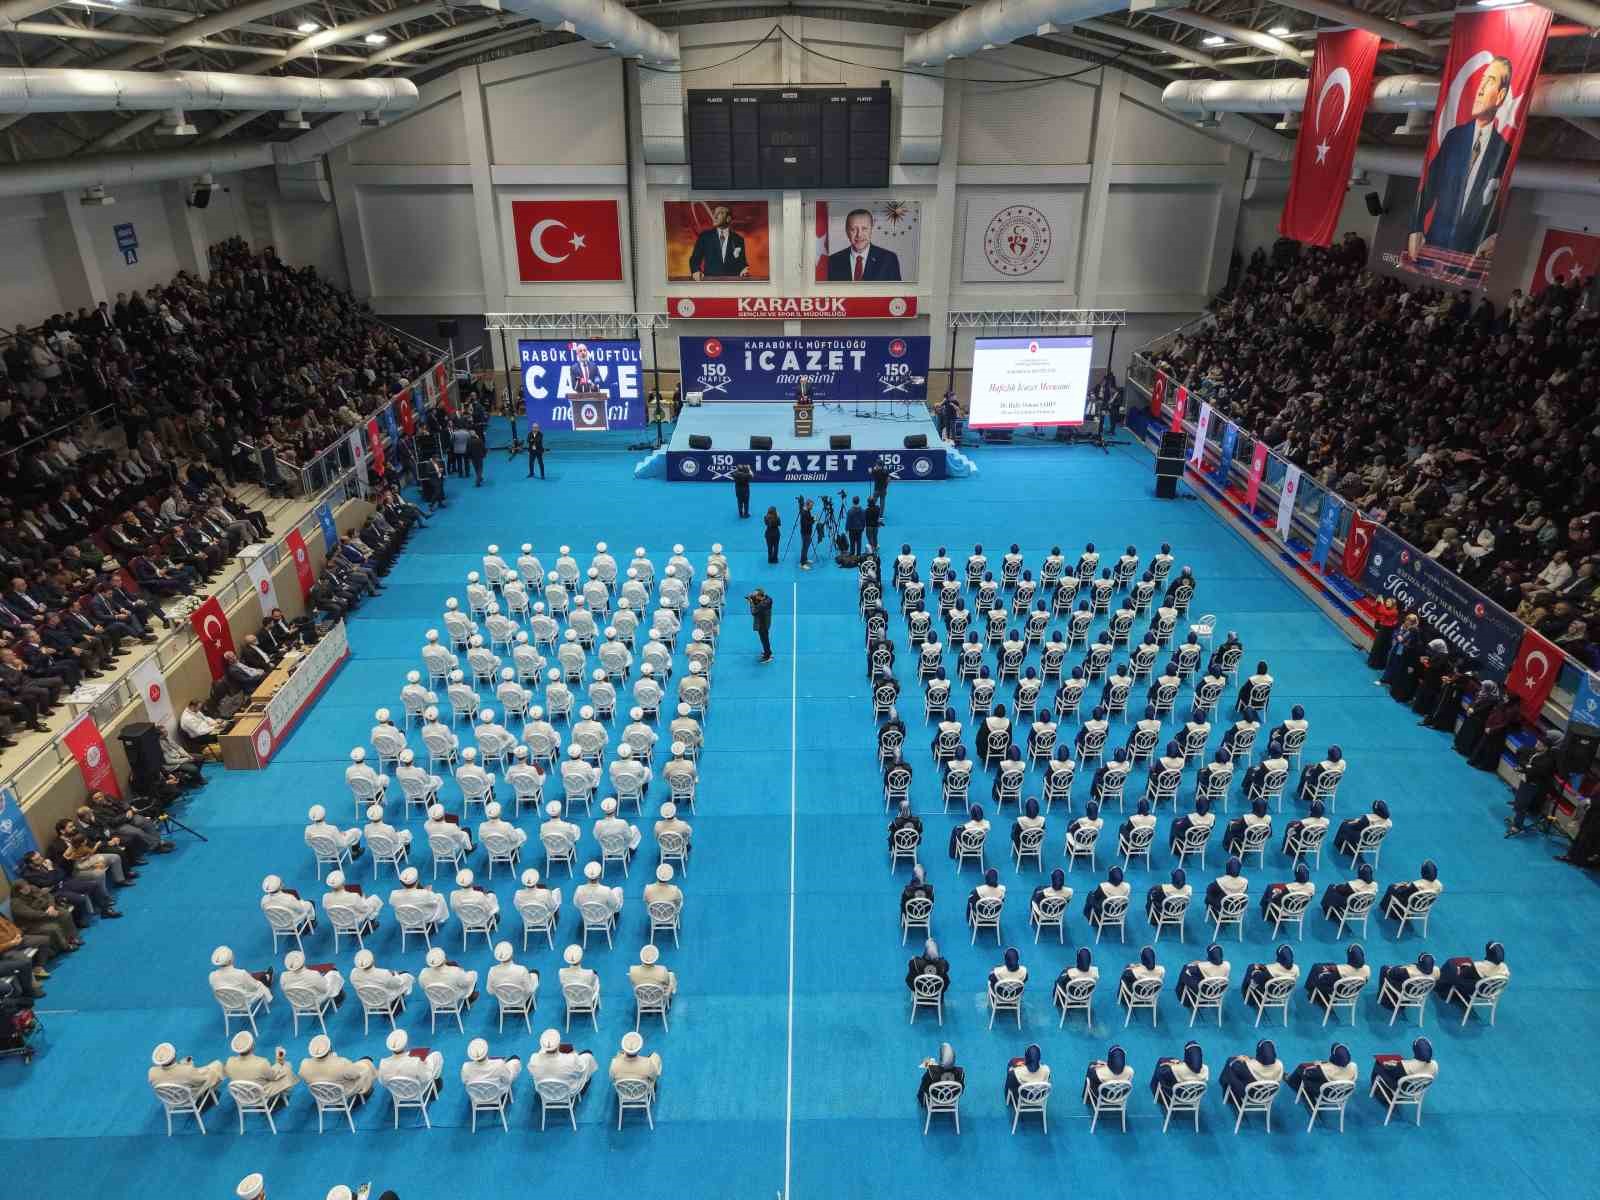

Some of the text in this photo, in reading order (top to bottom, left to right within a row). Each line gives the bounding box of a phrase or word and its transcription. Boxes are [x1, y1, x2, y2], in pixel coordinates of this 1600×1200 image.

[737, 297, 846, 312] KARABÜK
[744, 340, 793, 350] KARABÜK
[702, 363, 727, 376] 150
[884, 363, 910, 376] 150
[711, 454, 734, 466] 150
[1417, 601, 1482, 659] Geldiniz
